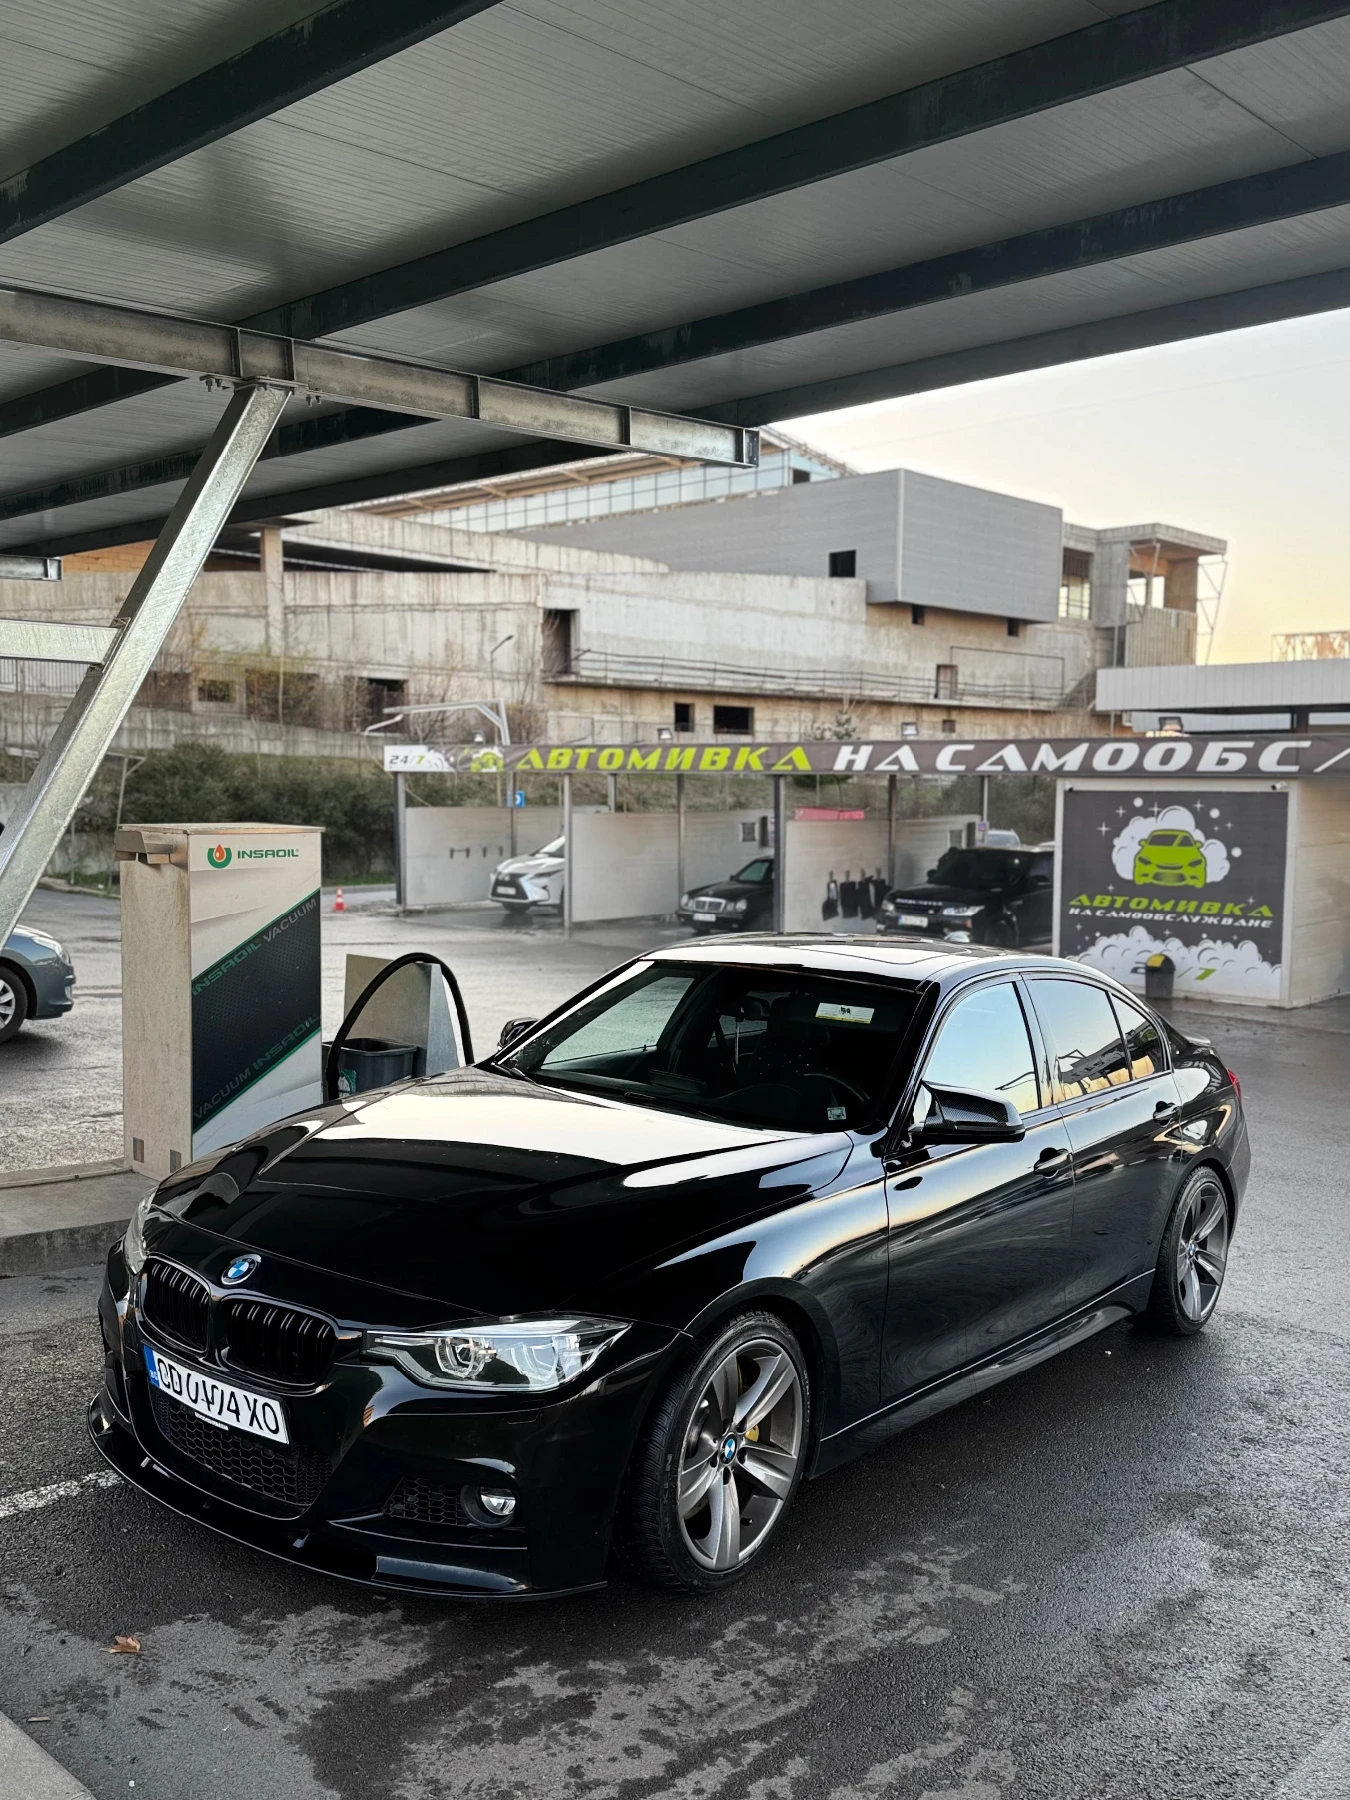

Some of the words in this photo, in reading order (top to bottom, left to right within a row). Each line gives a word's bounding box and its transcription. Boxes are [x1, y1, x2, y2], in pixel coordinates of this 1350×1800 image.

[389, 754, 426, 765] 24/7
[516, 746, 812, 771] АВТОМИВКА
[832, 744, 920, 771] НА
[237, 848, 299, 859] INSAOIL
[1068, 894, 1274, 917] АВТОМИВКА
[192, 943, 262, 996] INSAOIL
[263, 898, 317, 942] VACUUM
[194, 1067, 252, 1119] VACUUM
[252, 1015, 319, 1071] INSAOIL
